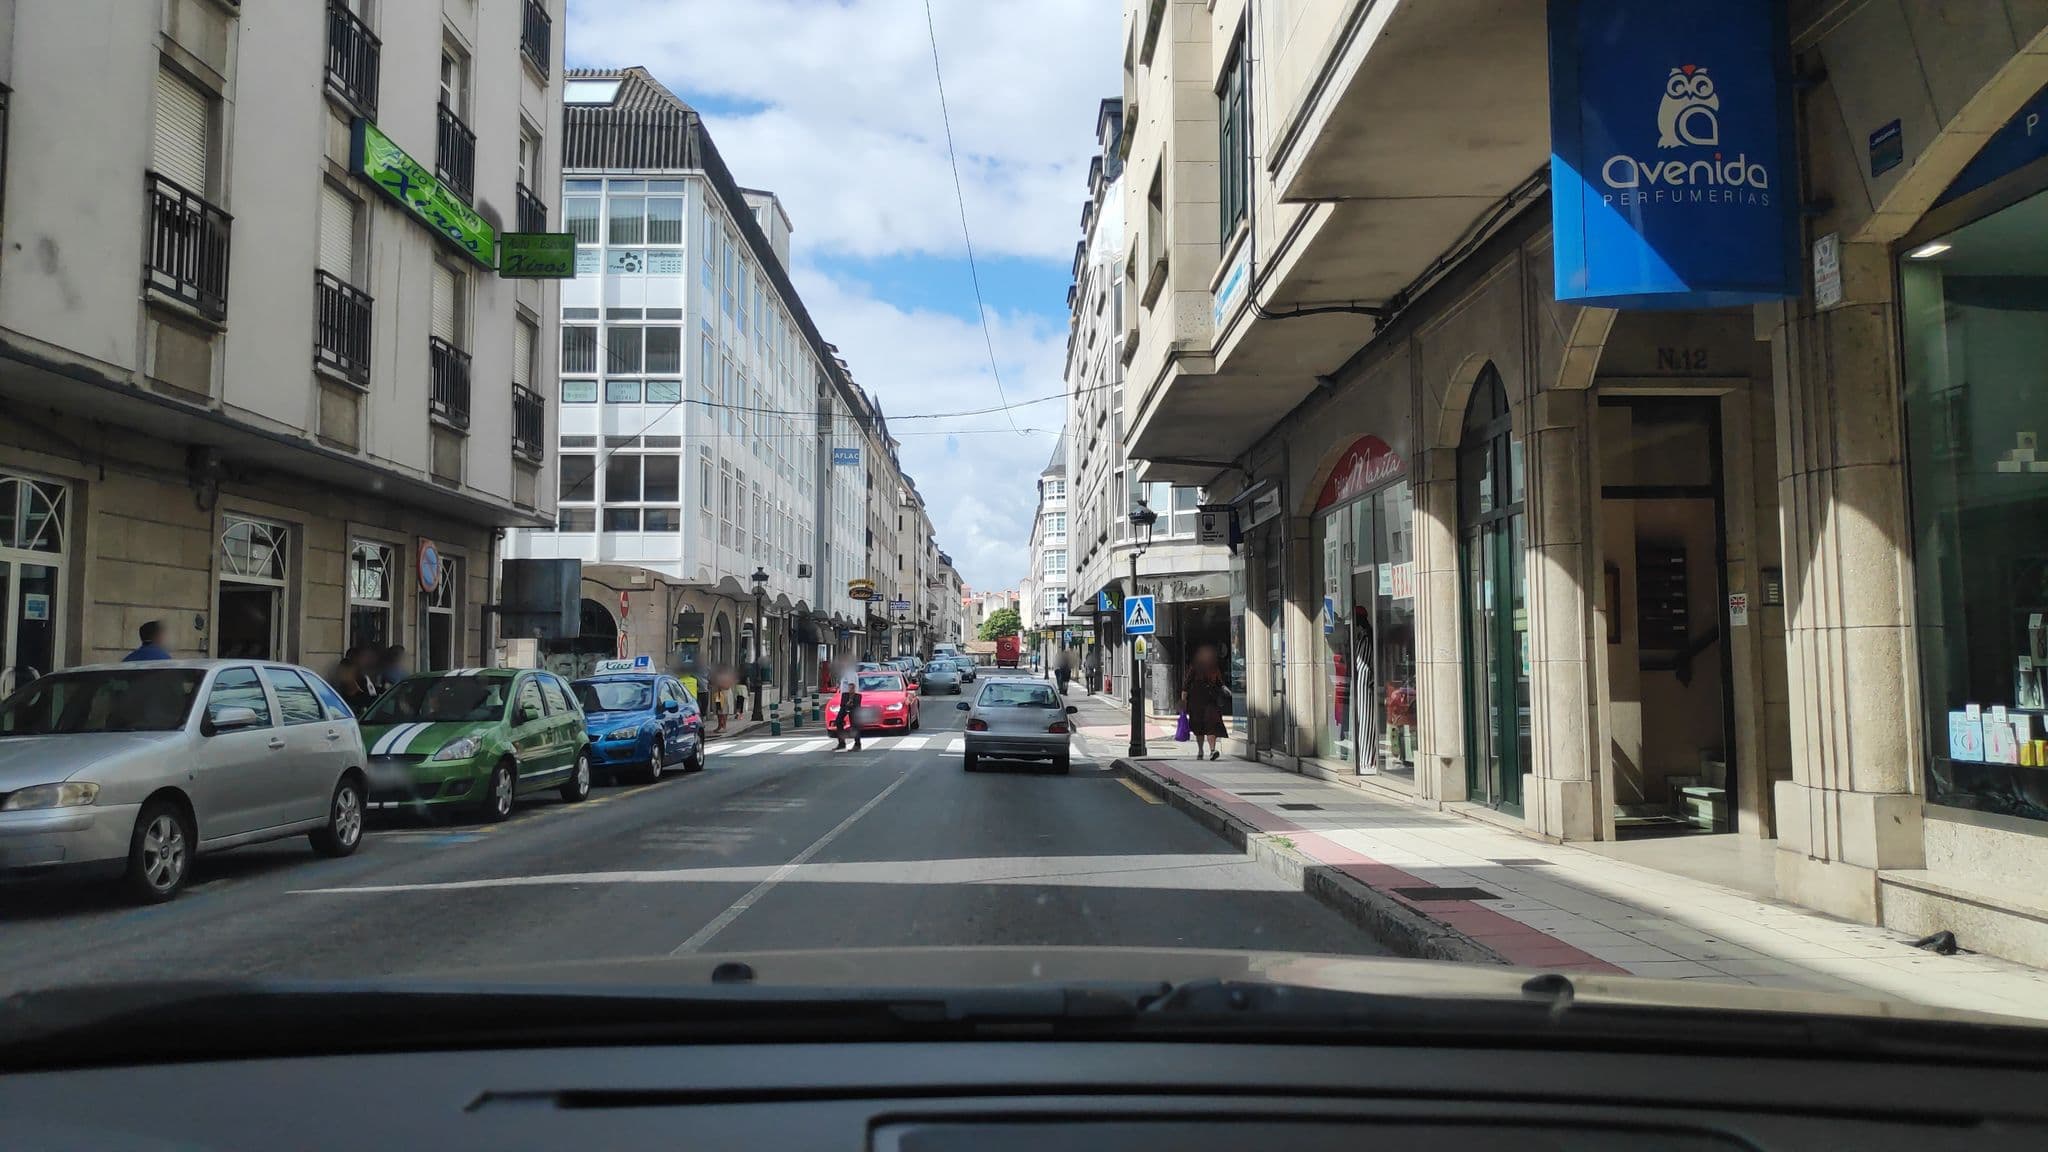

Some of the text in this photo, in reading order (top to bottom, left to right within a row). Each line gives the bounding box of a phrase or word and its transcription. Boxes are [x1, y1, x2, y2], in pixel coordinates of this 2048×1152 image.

[1602, 152, 1768, 189] avenida
[381, 162, 482, 253] Xiros
[1603, 188, 1769, 208] PERFUMERÍAS
[506, 254, 569, 273] Xiros
